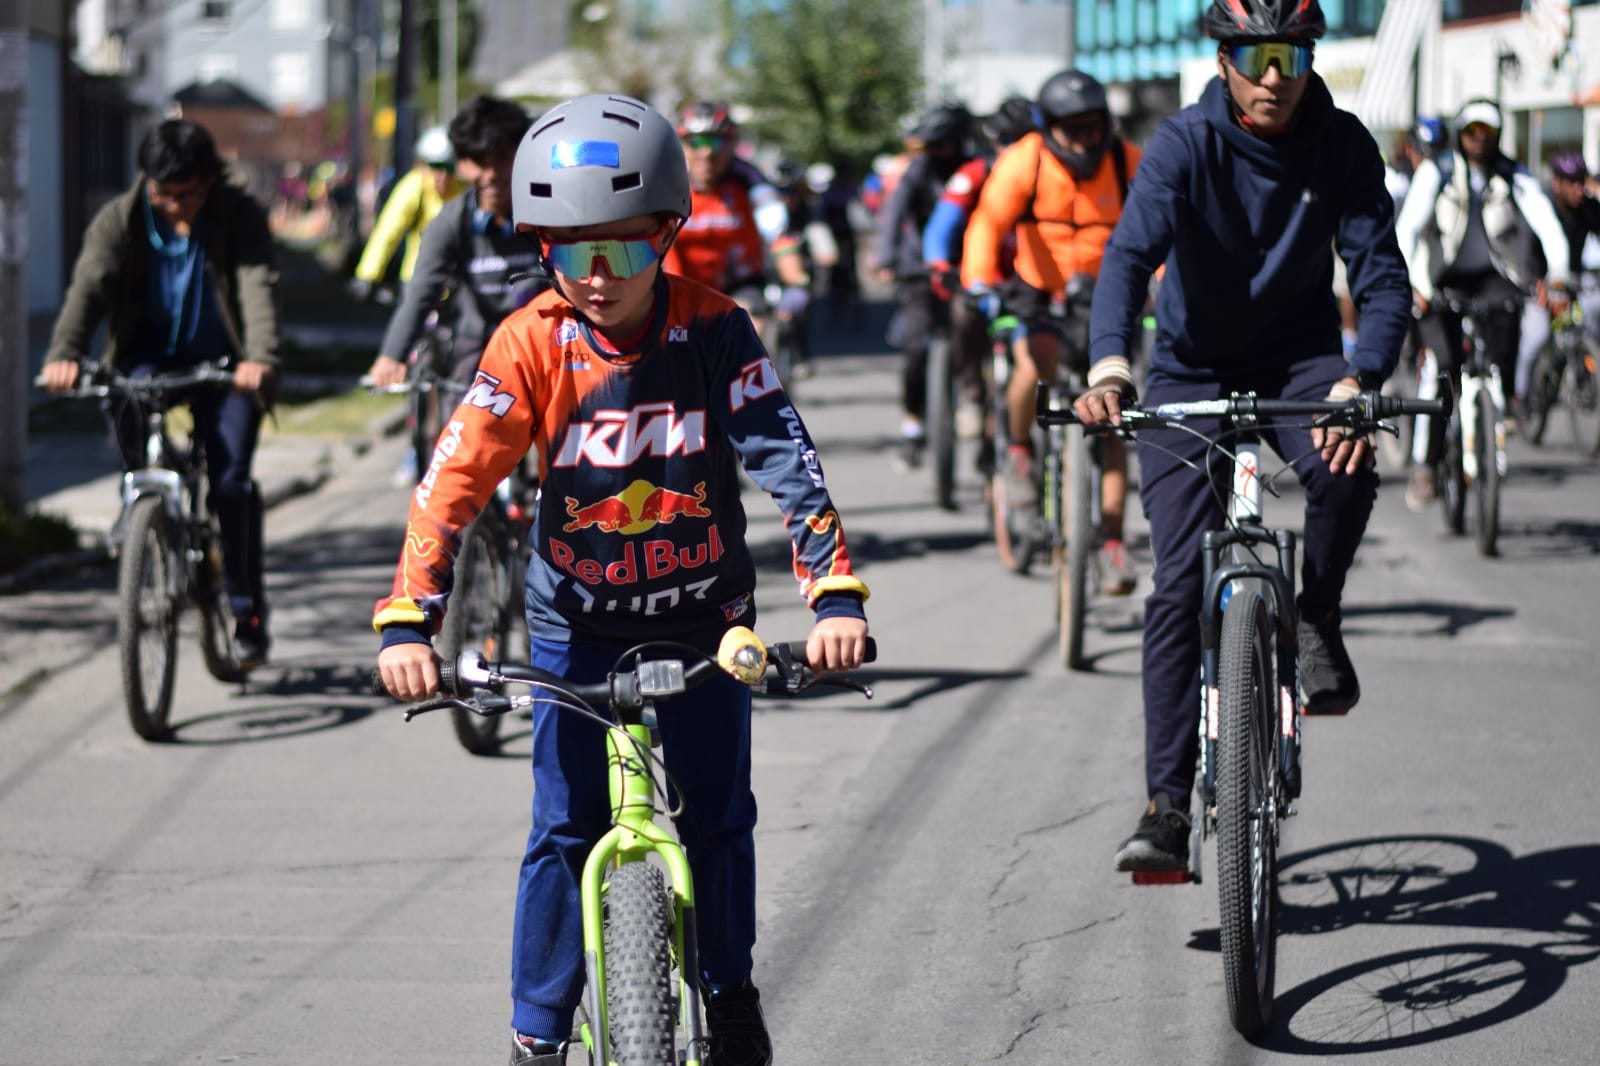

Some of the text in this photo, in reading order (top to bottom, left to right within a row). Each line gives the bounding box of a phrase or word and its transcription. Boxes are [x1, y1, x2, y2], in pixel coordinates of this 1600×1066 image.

[416, 420, 464, 510] KENDA
[552, 401, 705, 467] KTM
[550, 537, 637, 584] Red
